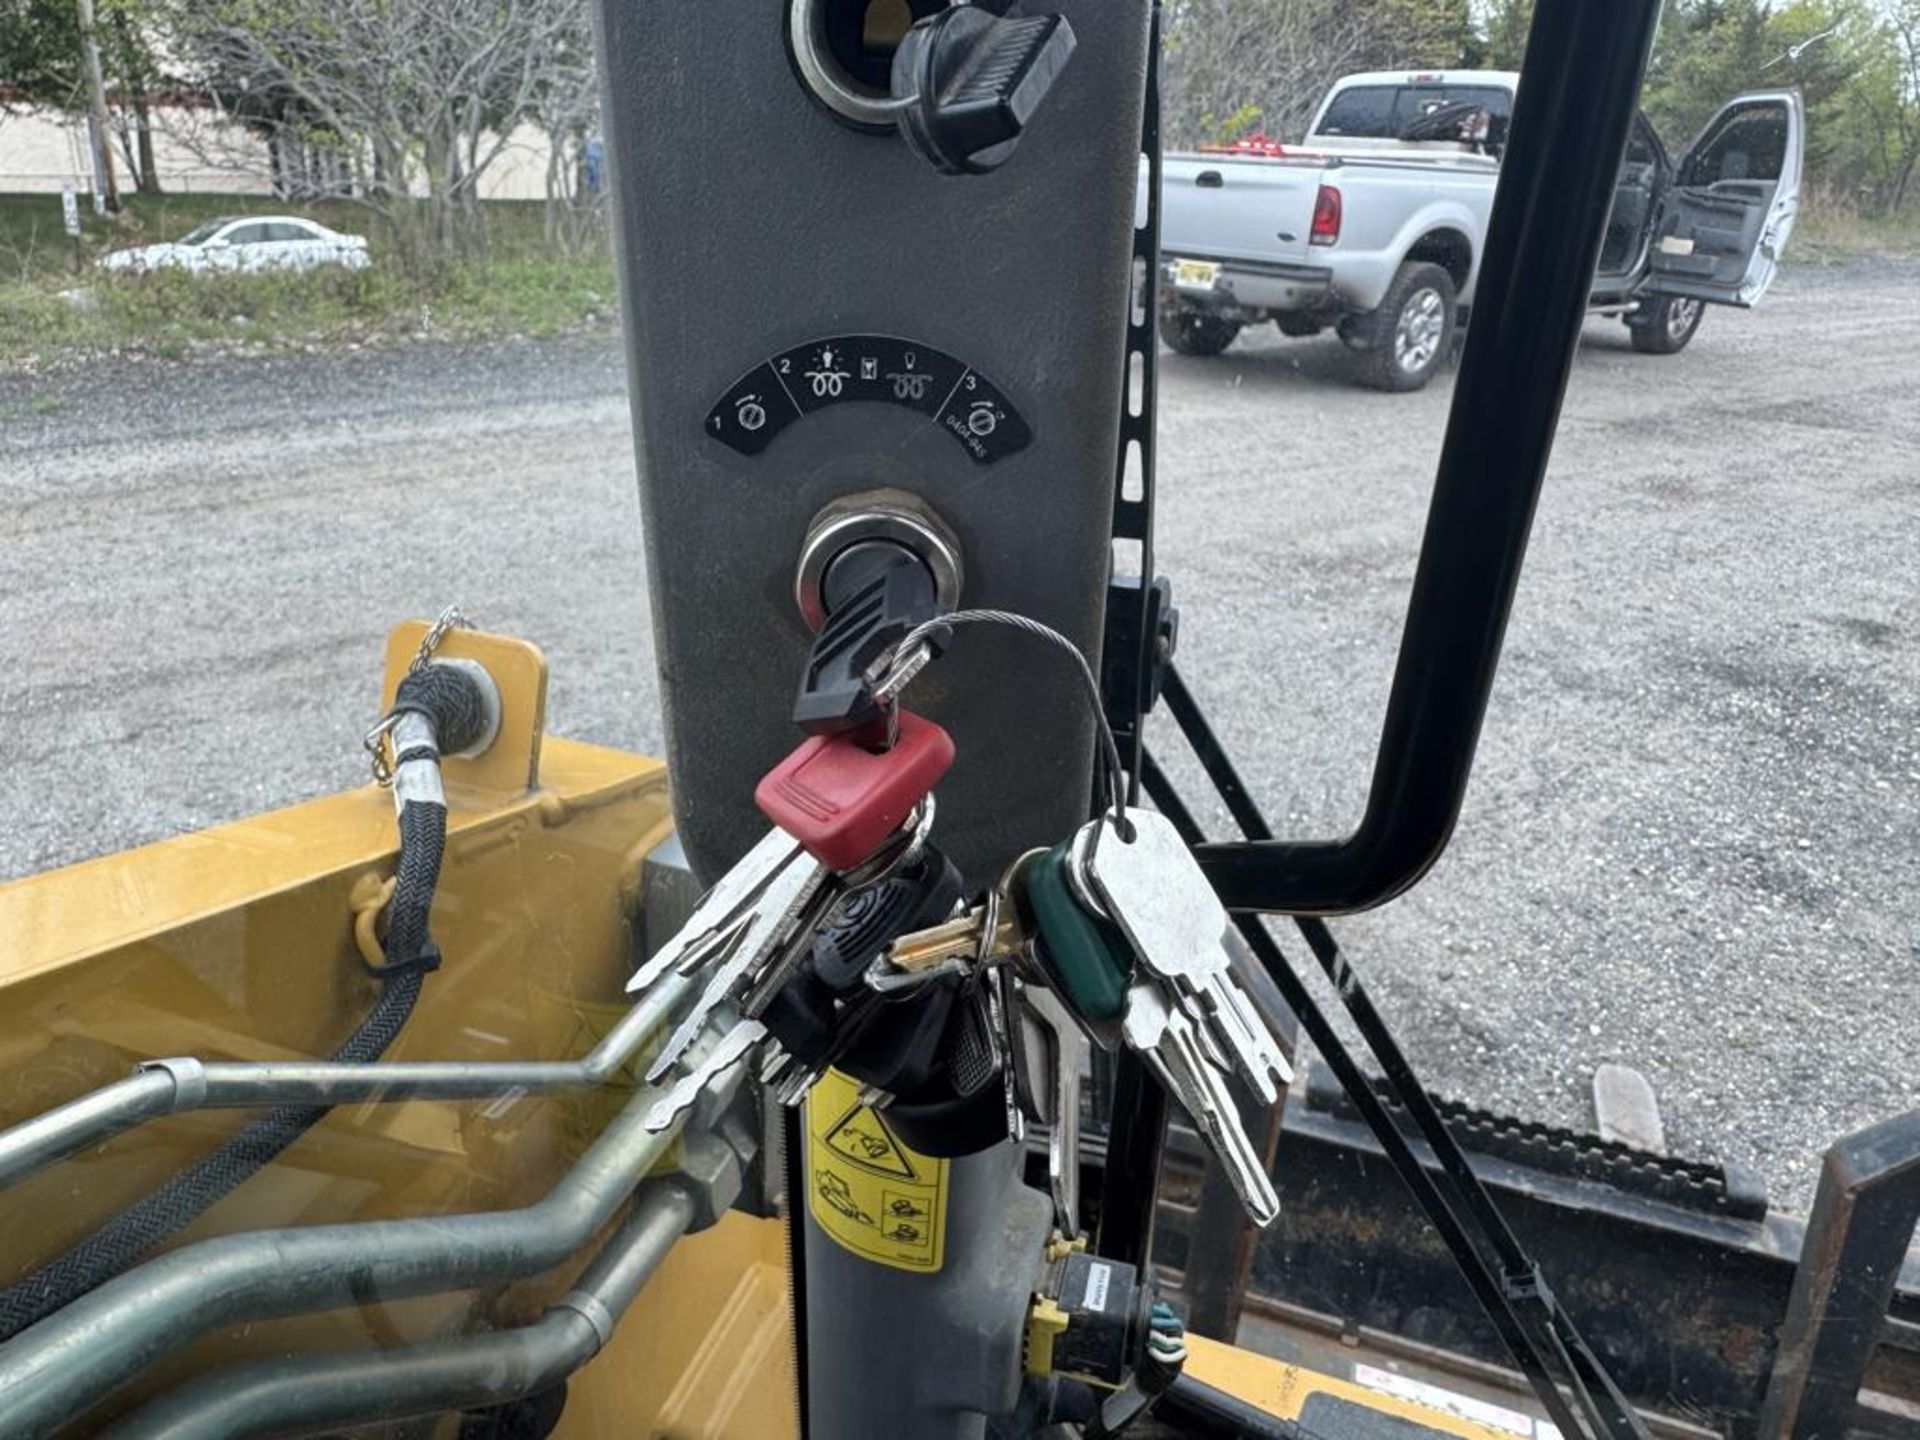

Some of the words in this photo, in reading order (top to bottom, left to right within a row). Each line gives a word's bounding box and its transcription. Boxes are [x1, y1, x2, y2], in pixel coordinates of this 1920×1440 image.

[780, 358, 791, 374] 2
[965, 375, 976, 391] 3
[714, 416, 721, 430] 1
